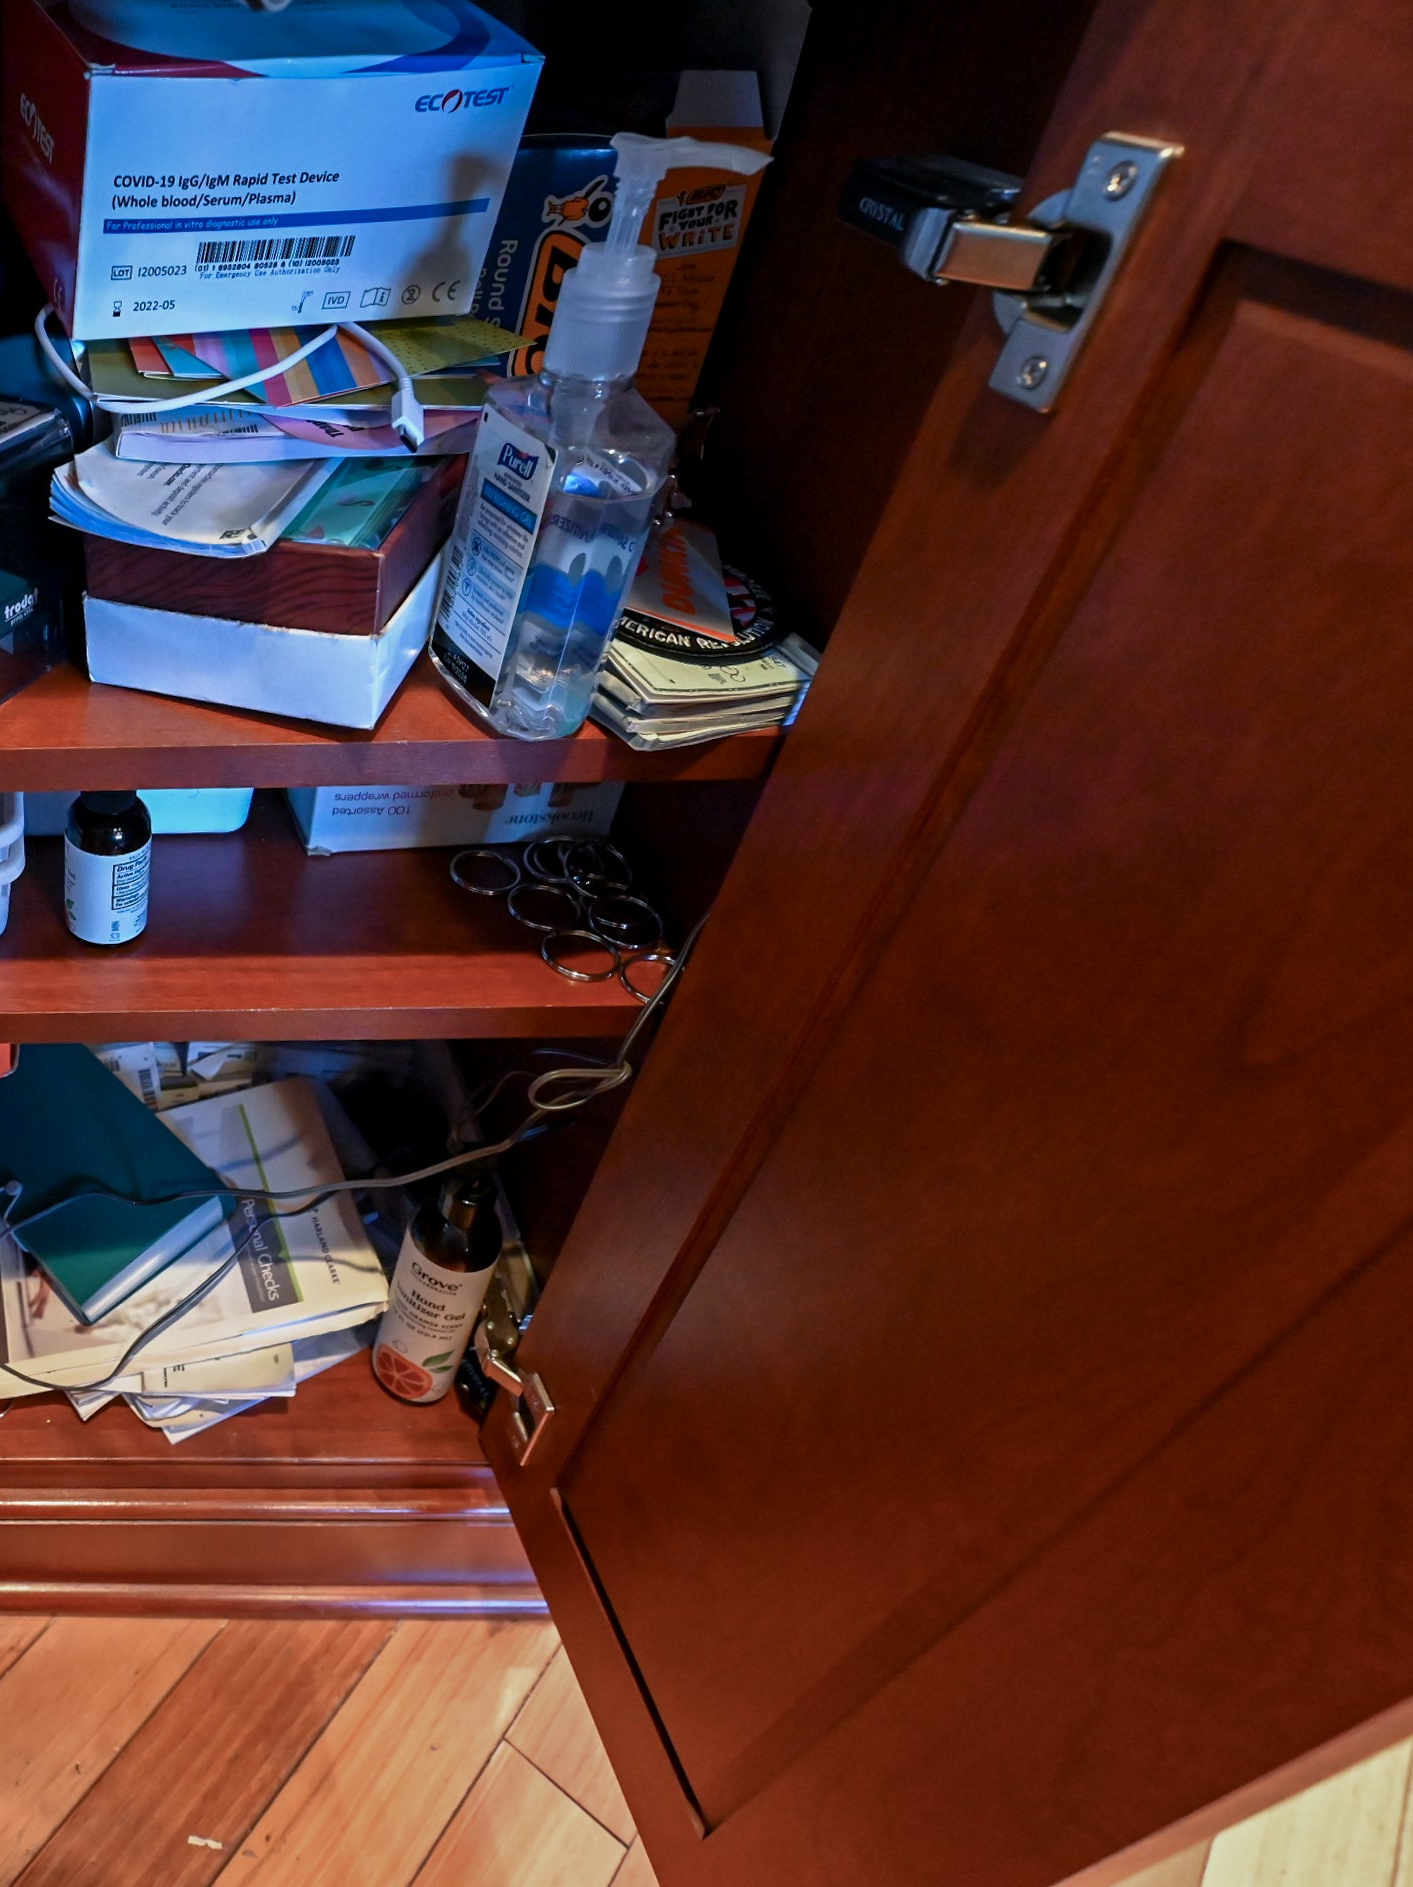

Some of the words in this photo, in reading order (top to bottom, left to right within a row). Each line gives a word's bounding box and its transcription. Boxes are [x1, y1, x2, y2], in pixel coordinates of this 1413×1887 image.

[415, 87, 509, 114] ECOTEST
[113, 174, 176, 188] COVID-19
[178, 173, 229, 190] IgG/IgM
[233, 173, 268, 189] Rapid
[272, 172, 296, 185] Test
[299, 171, 340, 184] Device
[112, 194, 158, 210] (Whole
[161, 190, 296, 210] blood/Serum/Plasma)
[708, 200, 738, 220] FOR
[106, 221, 121, 230] For
[123, 219, 173, 230] Professional
[175, 219, 183, 229] in
[184, 219, 204, 229] vitro
[205, 218, 245, 230] diagnostic
[247, 218, 261, 227] use
[262, 217, 279, 227] only
[679, 216, 714, 230] YOUR
[113, 269, 130, 277] LOT
[487, 239, 518, 310] Round
[133, 299, 176, 312] 2022-05
[327, 296, 345, 304] IVD
[502, 445, 535, 479] Purell
[620, 615, 692, 648] MERICAN
[696, 615, 777, 650] RELUTION
[334, 791, 389, 802] wrappers
[331, 805, 386, 816] Assorted
[387, 805, 411, 816] 100
[504, 811, 594, 826] Brookstone
[311, 1216, 330, 1254] HARLAND
[323, 1254, 341, 1285] CLARKE
[258, 1253, 281, 1302] Checks
[411, 1261, 459, 1292] Grove
[410, 1289, 446, 1311] Hand
[443, 1312, 466, 1321] Gel
